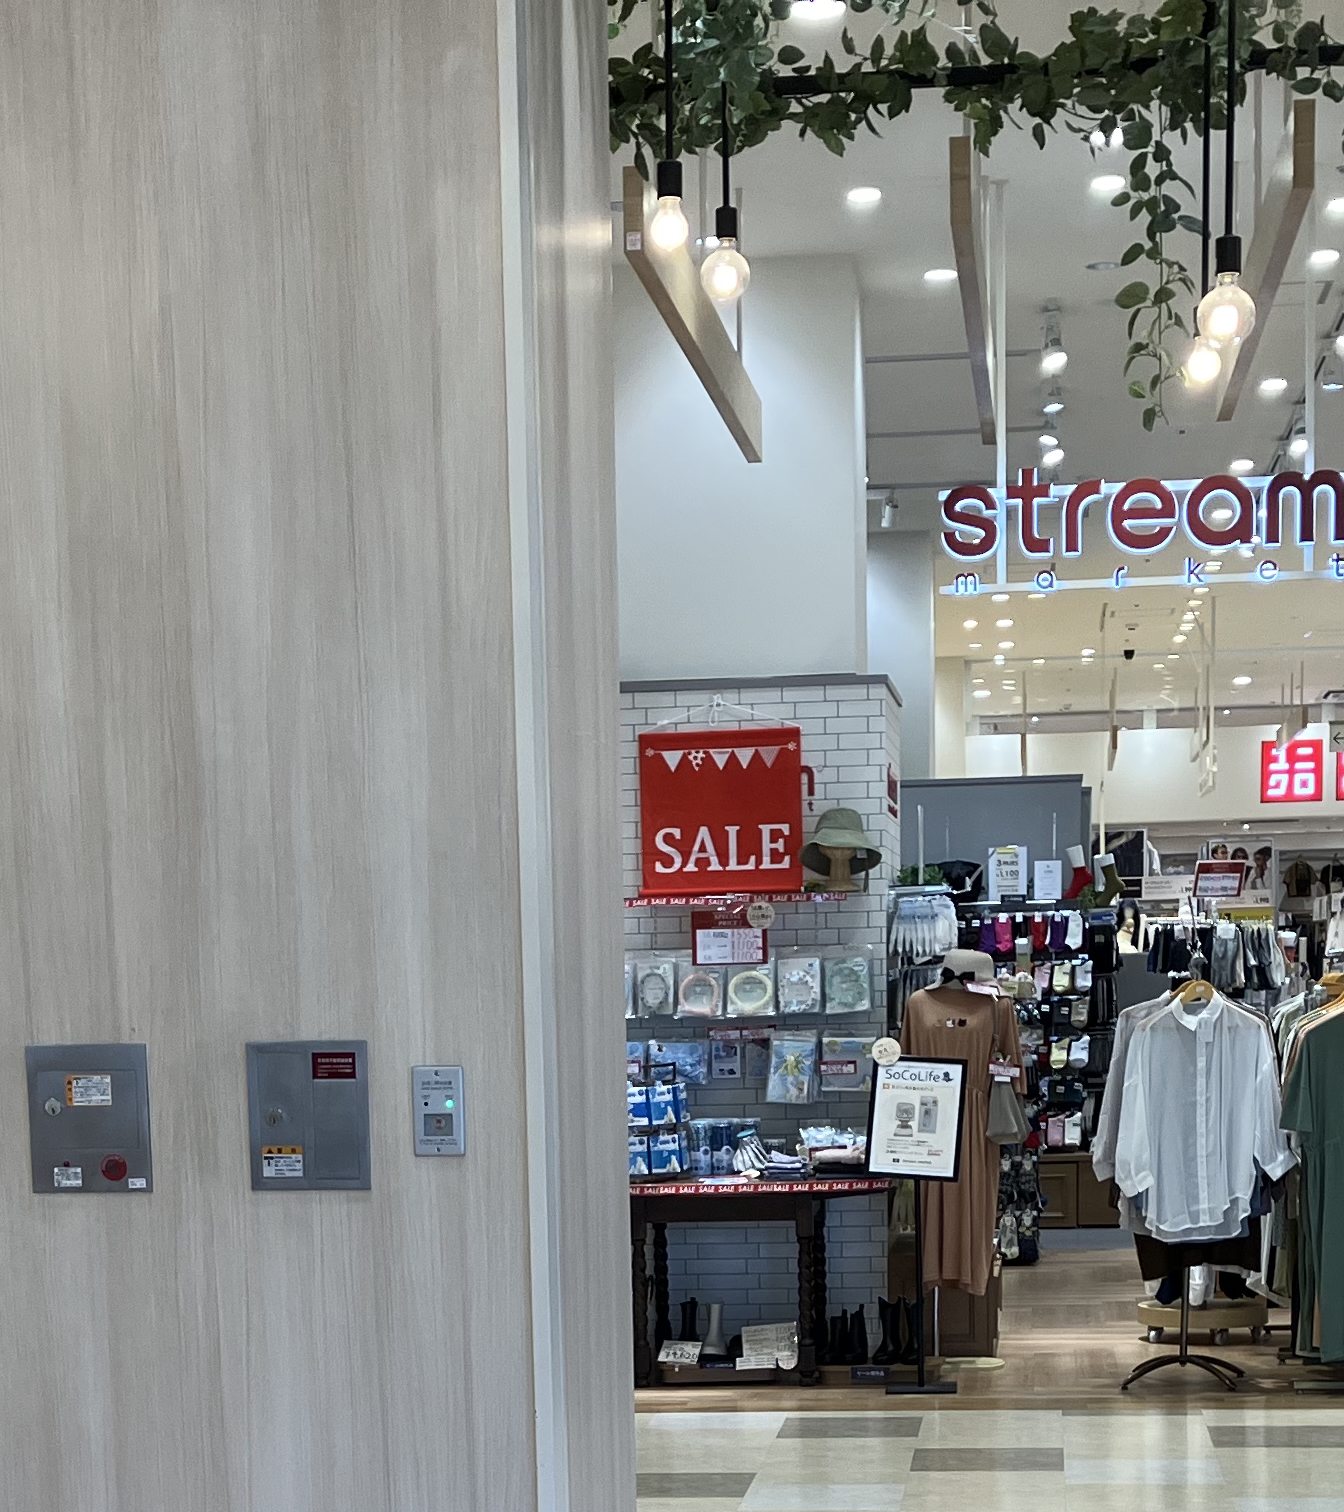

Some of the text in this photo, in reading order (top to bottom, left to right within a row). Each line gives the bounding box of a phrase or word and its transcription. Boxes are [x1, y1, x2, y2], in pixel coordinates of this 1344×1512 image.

[1267, 772, 1316, 797] クロ
[654, 823, 791, 873] SALE
[884, 1068, 941, 1083] SoCoLife
